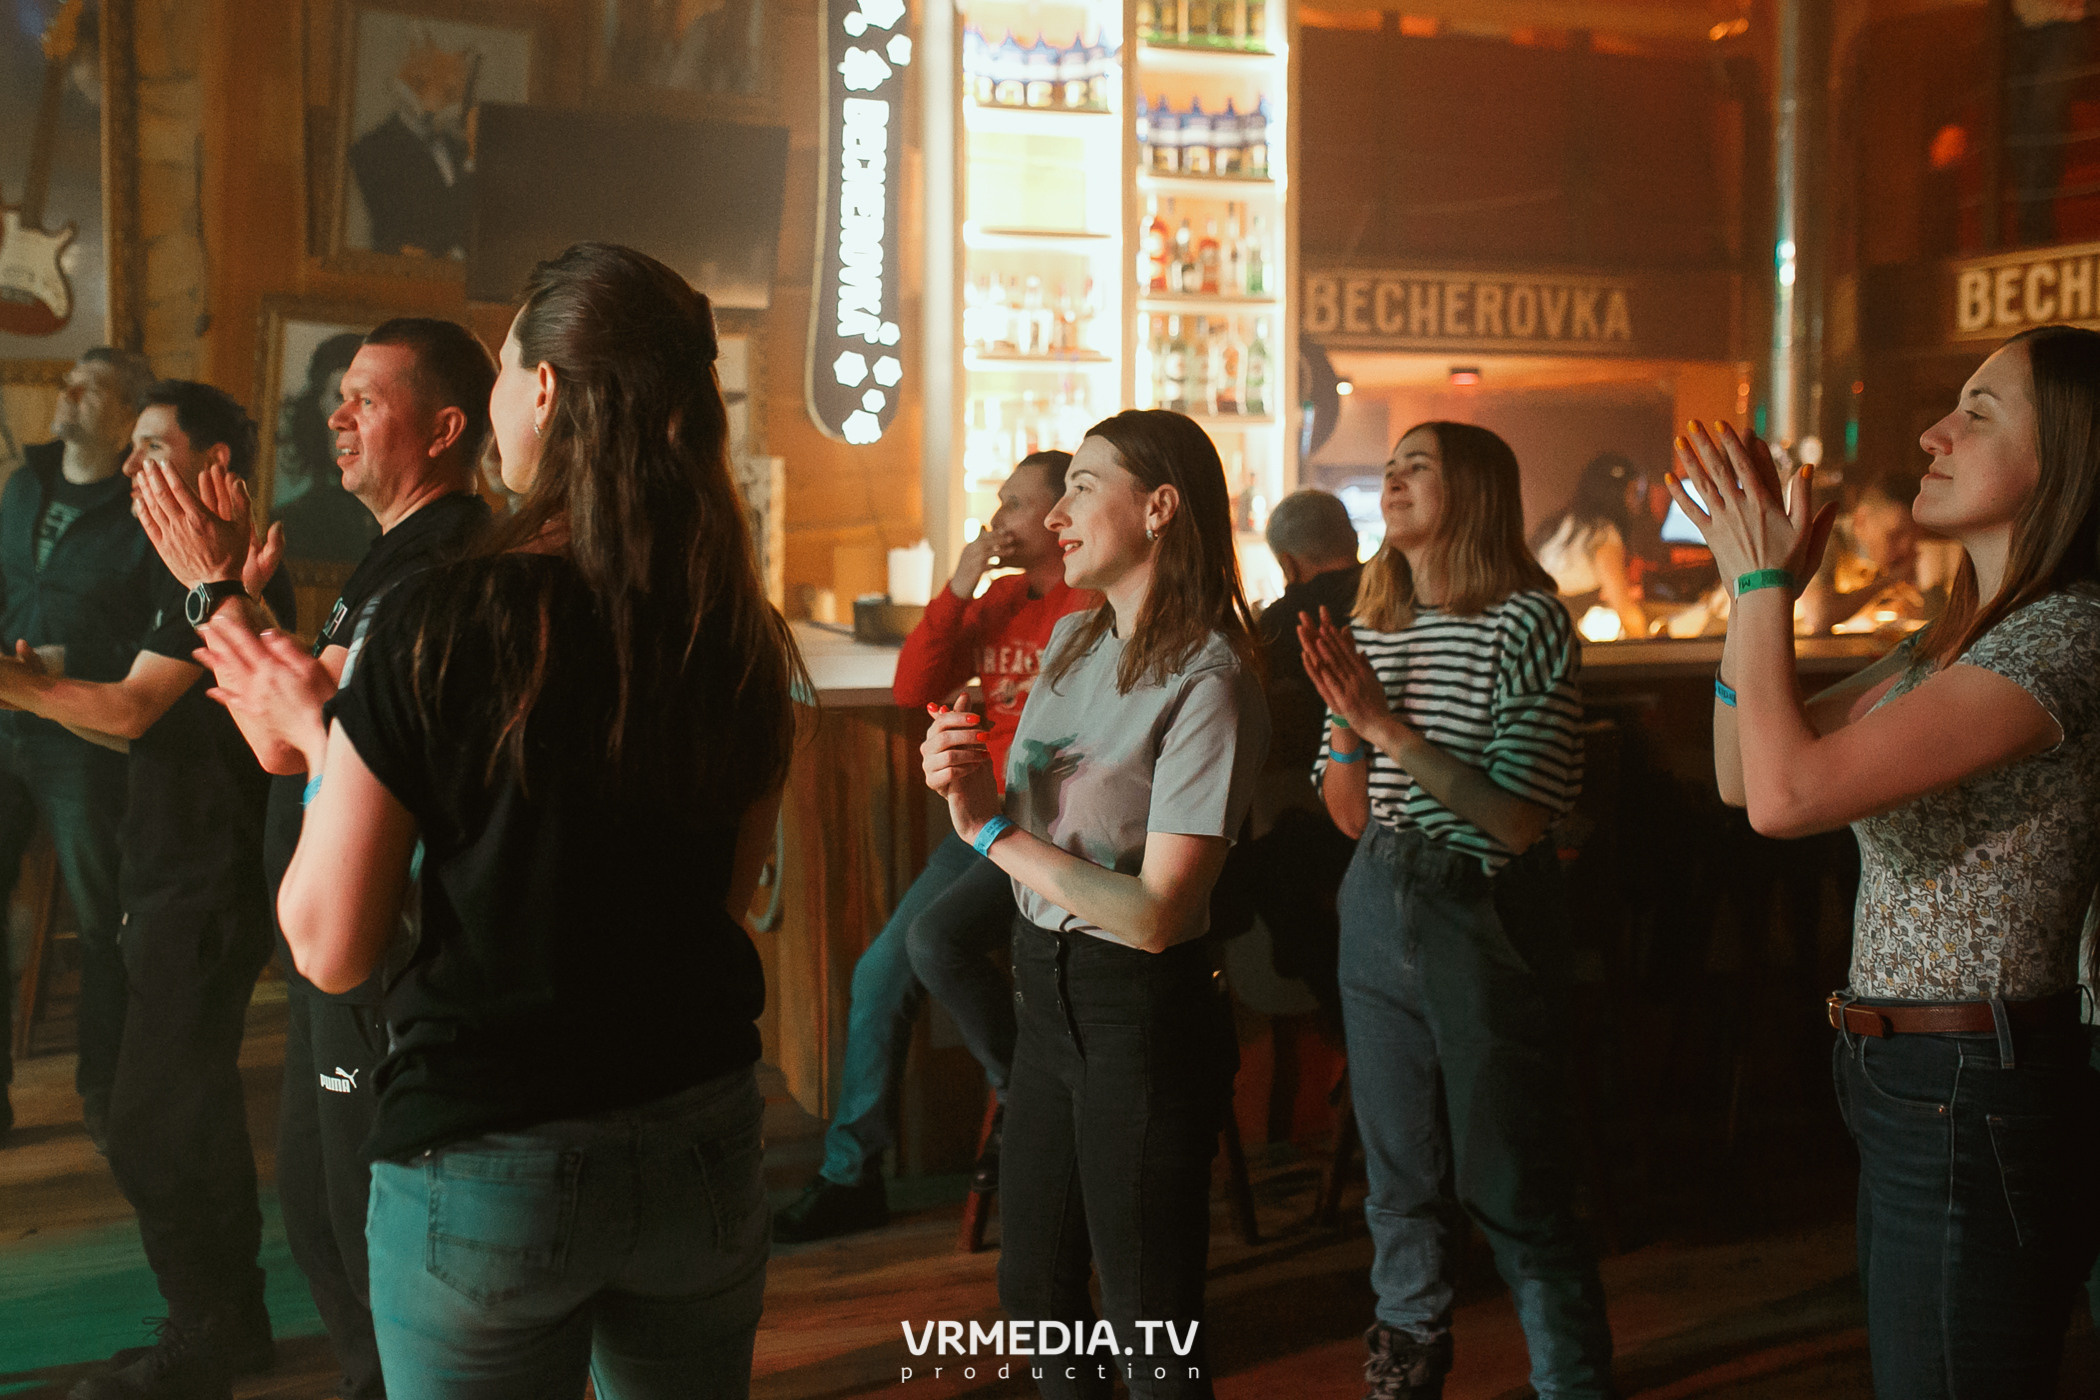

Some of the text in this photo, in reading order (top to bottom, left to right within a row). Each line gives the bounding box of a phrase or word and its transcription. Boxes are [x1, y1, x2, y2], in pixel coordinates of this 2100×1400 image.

[1303, 277, 1632, 340] BECHEROVKA
[1957, 257, 2100, 331] BECH
[320, 1073, 351, 1093] PUMA
